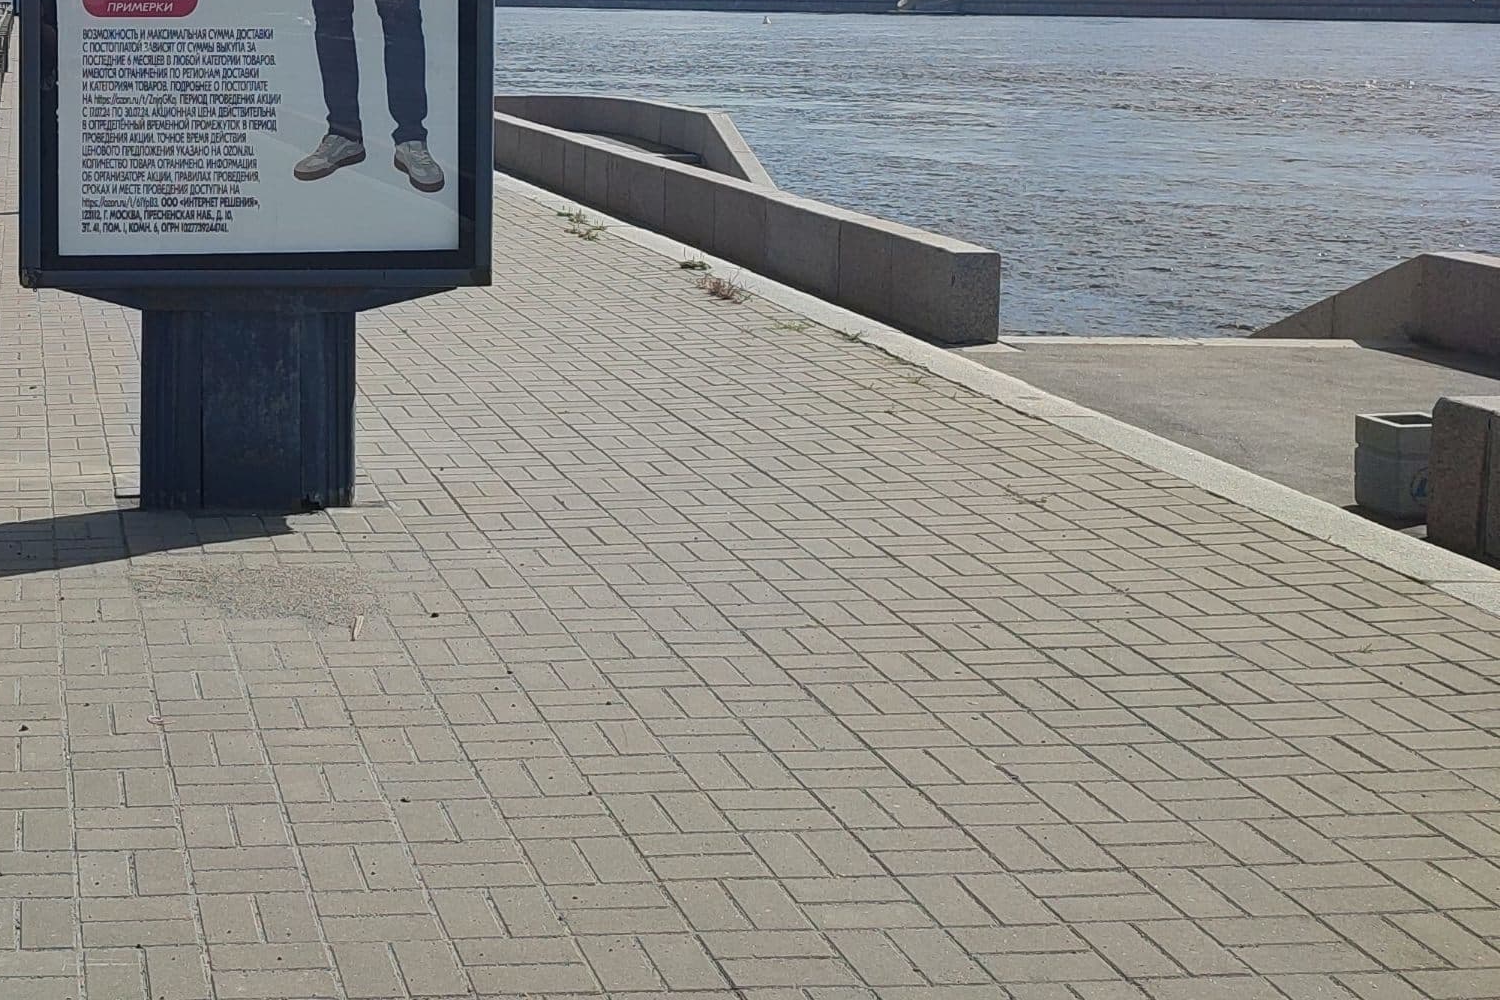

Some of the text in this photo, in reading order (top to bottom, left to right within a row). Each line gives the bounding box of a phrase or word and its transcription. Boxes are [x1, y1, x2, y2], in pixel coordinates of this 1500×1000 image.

[107, 2, 173, 12] ПРИМЕРКИ
[83, 29, 138, 39] ВОЗМОЖНОСТЬ
[208, 29, 234, 39] СУММА
[236, 29, 273, 40] ДОСТАВКИ
[222, 68, 259, 79] ДОСТАВКИ
